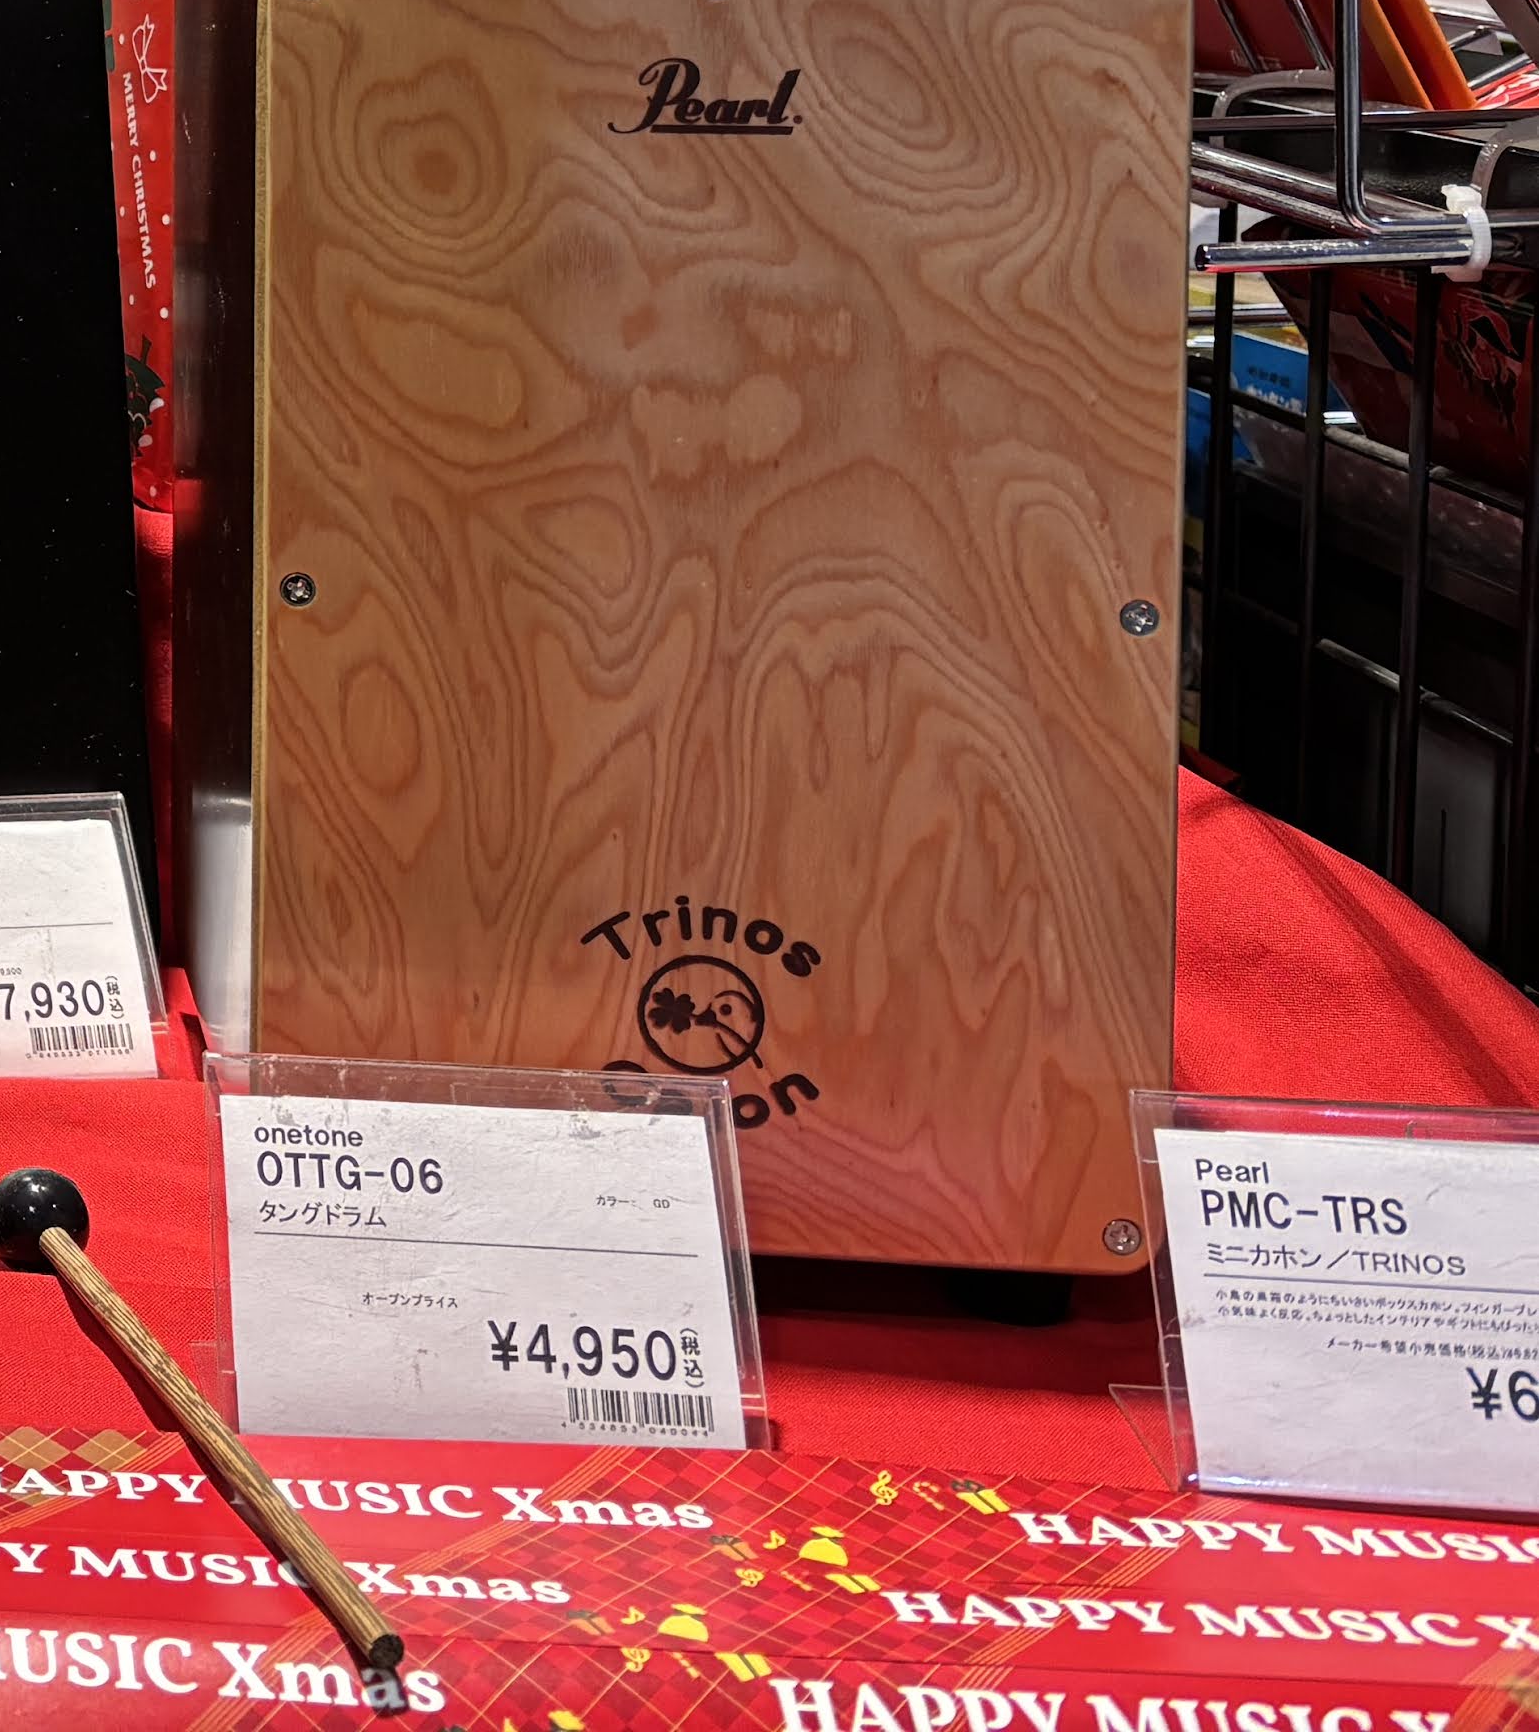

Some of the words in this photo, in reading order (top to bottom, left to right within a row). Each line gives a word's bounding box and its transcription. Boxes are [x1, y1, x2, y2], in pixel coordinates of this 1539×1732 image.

[121, 72, 140, 150] MERRY
[607, 57, 802, 135] Pearl
[130, 153, 157, 290] CHRISTMAS
[580, 895, 821, 978] Trinos
[254, 1125, 363, 1147] onetone
[257, 1151, 444, 1194] OTTG-06
[1195, 1158, 1270, 1184] Pearl
[259, 1200, 387, 1227] タングドラム
[653, 1199, 670, 1209] GD
[1200, 1189, 1408, 1235] PMC-TRS
[487, 1320, 677, 1381] ¥4,950
[679, 1328, 705, 1388] (税込)
[493, 1486, 713, 1529] Xmas
[1010, 1511, 1295, 1554] HAPPY
[345, 1561, 571, 1604] Xmas
[879, 1589, 1178, 1635] HAPPY
[1183, 1601, 1479, 1649] MUSIC
[216, 1641, 446, 1714] Xmas
[767, 1677, 1067, 1732] HAPPY
